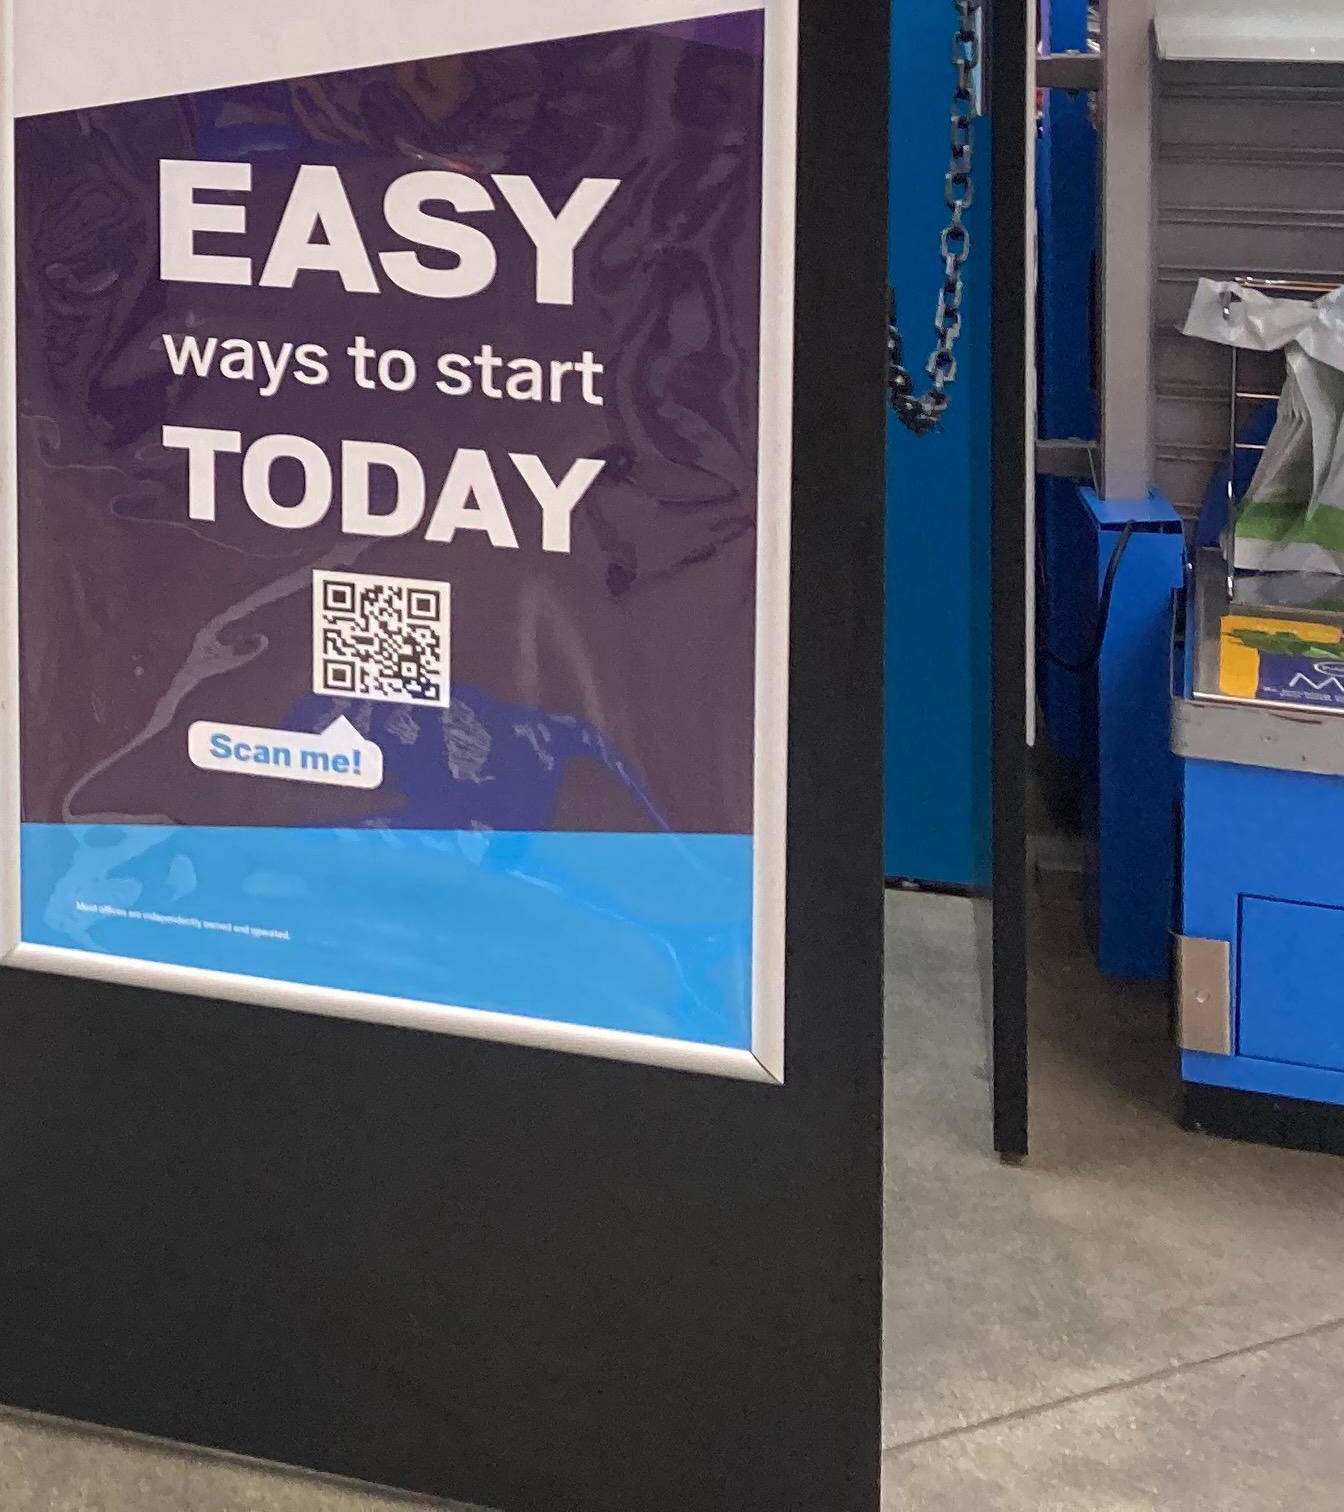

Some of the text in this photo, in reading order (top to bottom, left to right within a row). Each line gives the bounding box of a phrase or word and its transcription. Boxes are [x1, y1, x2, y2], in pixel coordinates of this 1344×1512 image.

[159, 159, 622, 306] EASY
[161, 333, 604, 406] ways to start
[162, 424, 606, 553] TODAY
[209, 733, 362, 775] Scan me!
